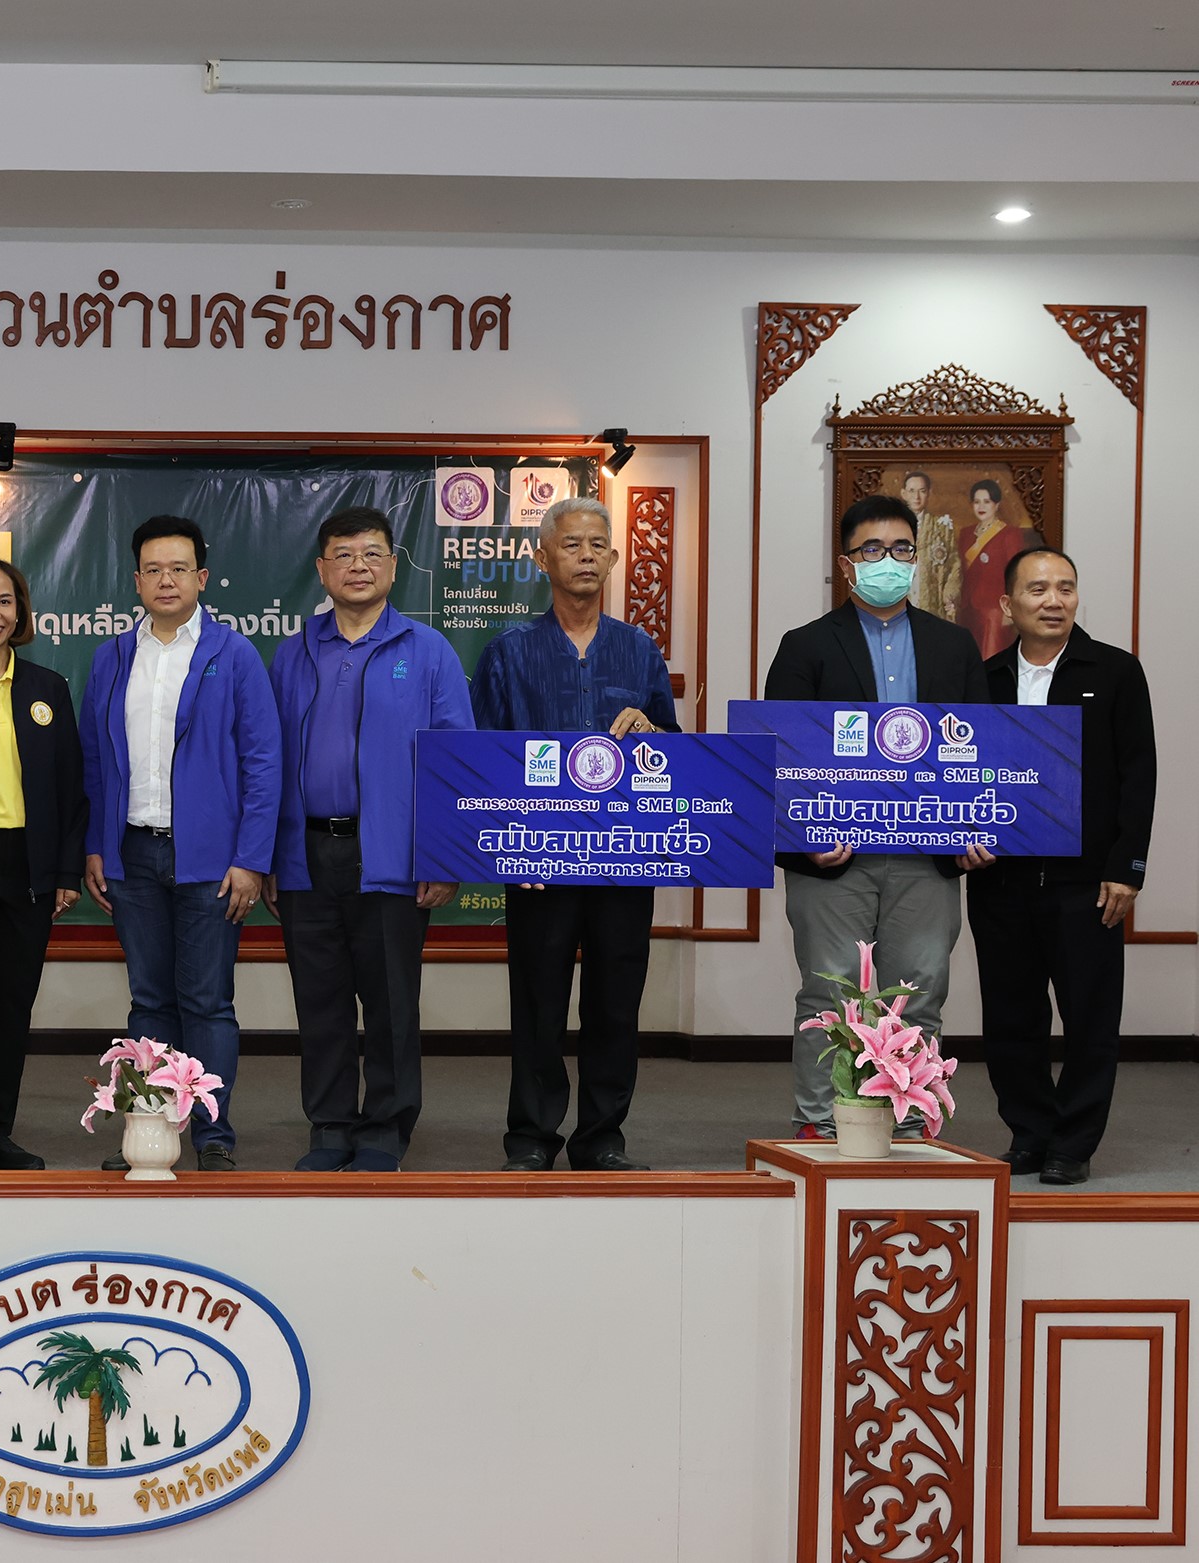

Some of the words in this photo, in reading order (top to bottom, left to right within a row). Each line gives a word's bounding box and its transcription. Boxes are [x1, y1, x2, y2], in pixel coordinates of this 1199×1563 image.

[444, 561, 460, 569] THE
[443, 584, 497, 599] โลกเปลี่ยน
[443, 602, 529, 617] อุตสาหกรรมปรับ
[838, 730, 864, 740] SME
[837, 744, 864, 753] Bank
[529, 760, 556, 770] SME
[529, 774, 556, 783] Bank
[634, 776, 669, 784] DIPROM
[776, 767, 907, 785] ระทรวงอุตสาหกรรม
[915, 771, 935, 782] และ
[943, 768, 979, 783] SME
[982, 768, 995, 783] D
[998, 769, 1038, 784] Bank
[458, 797, 599, 815] กระทรวงอุตสาหกรรม
[608, 801, 628, 812] และ
[637, 798, 672, 813] SME
[676, 798, 688, 813] D
[692, 799, 732, 814] Bank
[788, 789, 1017, 829] สนับสนุนสินเชื่อ
[477, 819, 711, 860] สนับสนุนสินเชื่อ
[806, 827, 949, 848] ให้กับผู้ประกอบการ
[951, 832, 997, 847] SMEs
[496, 858, 643, 879] ให้กับผู้ประกอบการ
[644, 863, 690, 877] SMEs
[72, 1263, 242, 1331] ร่องกาศ
[134, 1424, 271, 1512] จังหวัดแพร่
